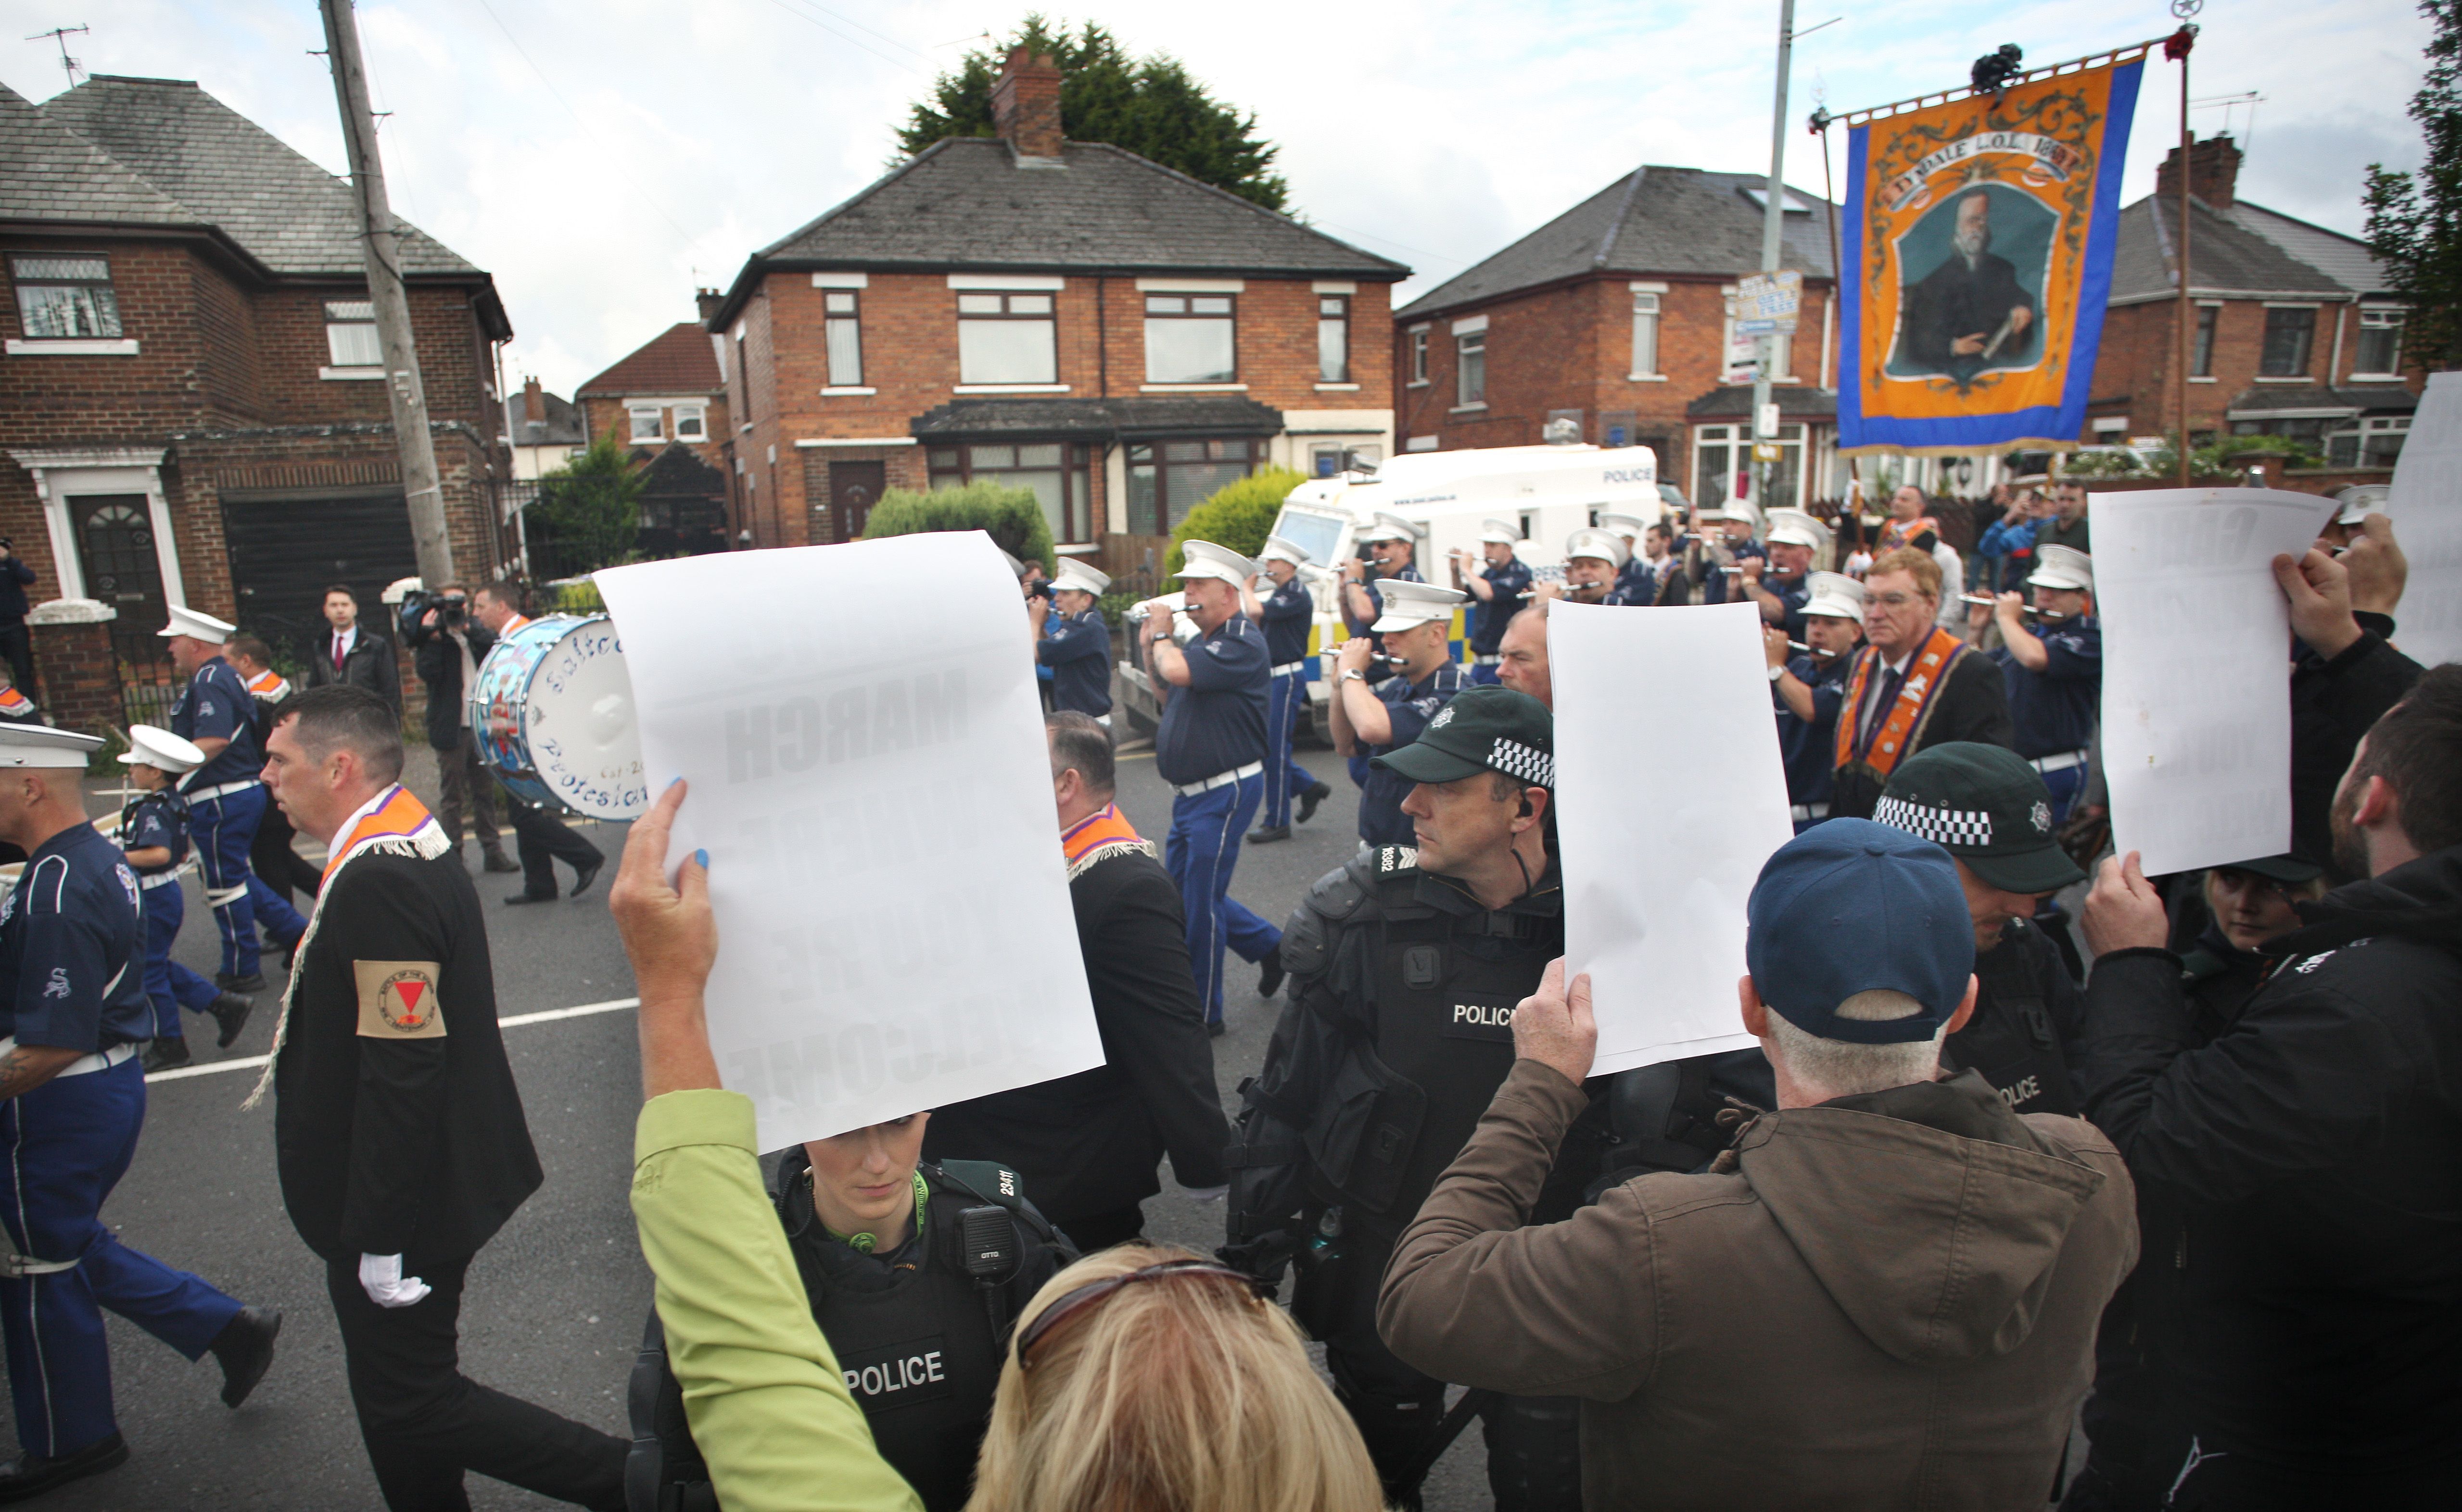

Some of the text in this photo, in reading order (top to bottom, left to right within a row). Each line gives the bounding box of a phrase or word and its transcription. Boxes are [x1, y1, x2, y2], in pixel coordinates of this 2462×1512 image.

[1603, 467, 1652, 483] POLICE
[1381, 847, 1395, 872] 16382
[1453, 1005, 1516, 1026] POLIC
[1999, 1075, 2041, 1106] OLICE
[999, 1170, 1014, 1196] 23411
[843, 1351, 944, 1395] POLICE
